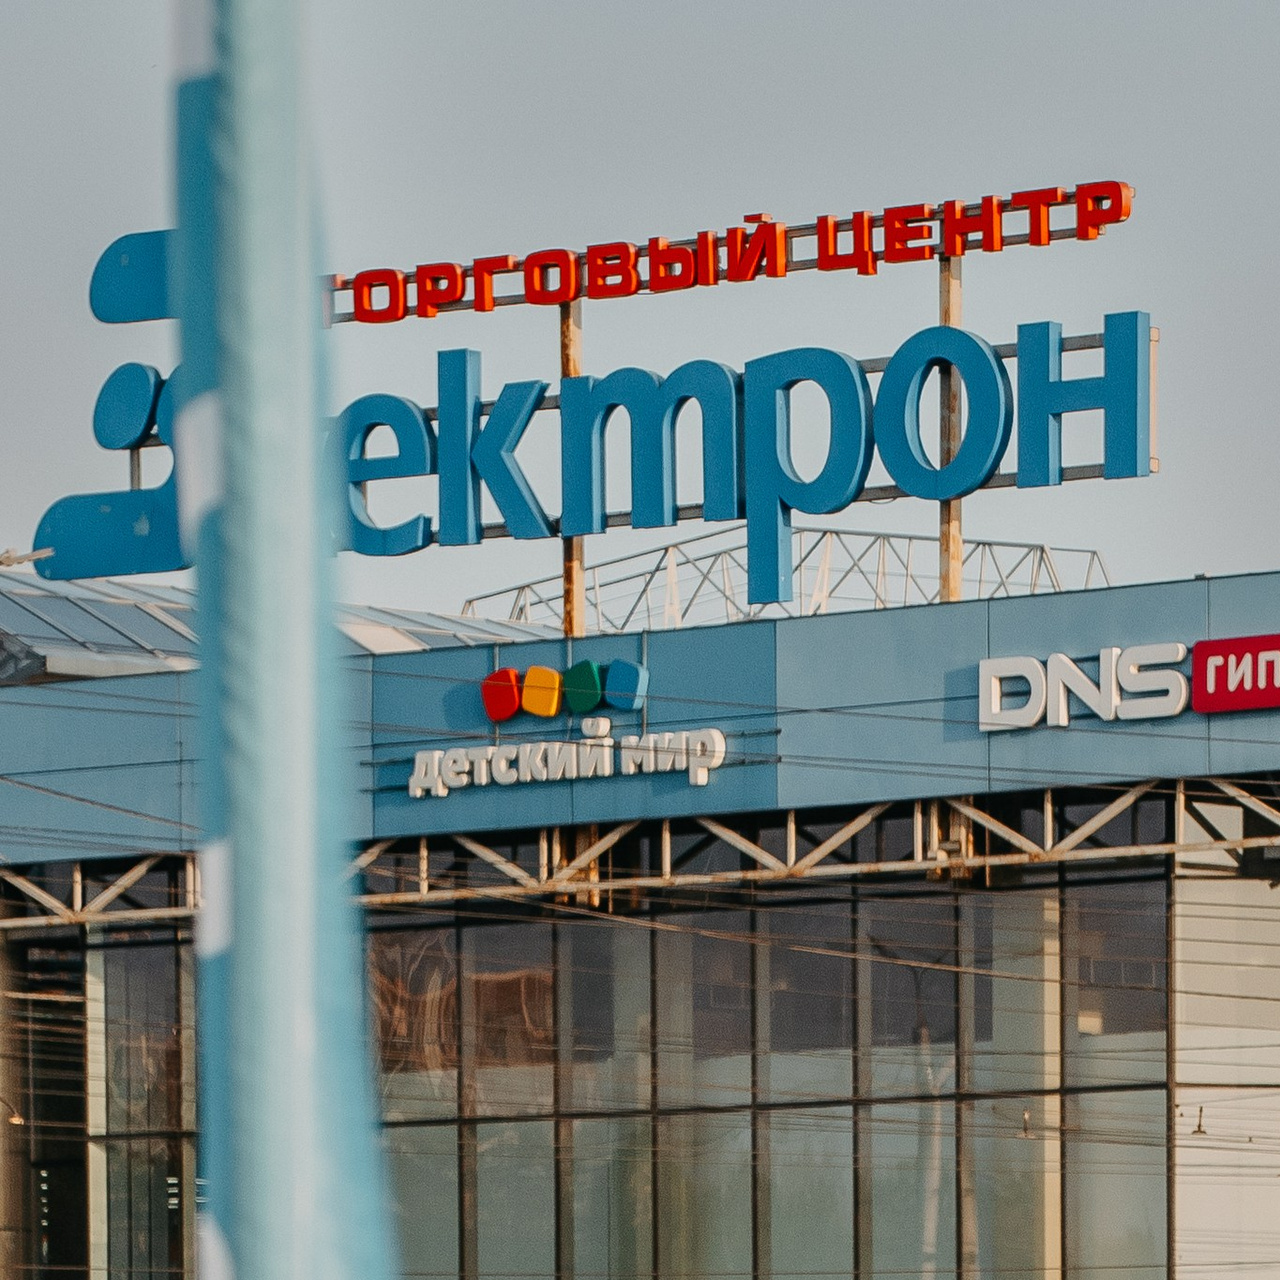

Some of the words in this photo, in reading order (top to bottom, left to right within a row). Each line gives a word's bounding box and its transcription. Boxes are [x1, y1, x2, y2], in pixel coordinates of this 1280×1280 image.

[816, 181, 1133, 275] ЦЕНТР
[979, 642, 1189, 732] DNS
[408, 716, 614, 798] детский
[620, 726, 726, 787] мир
